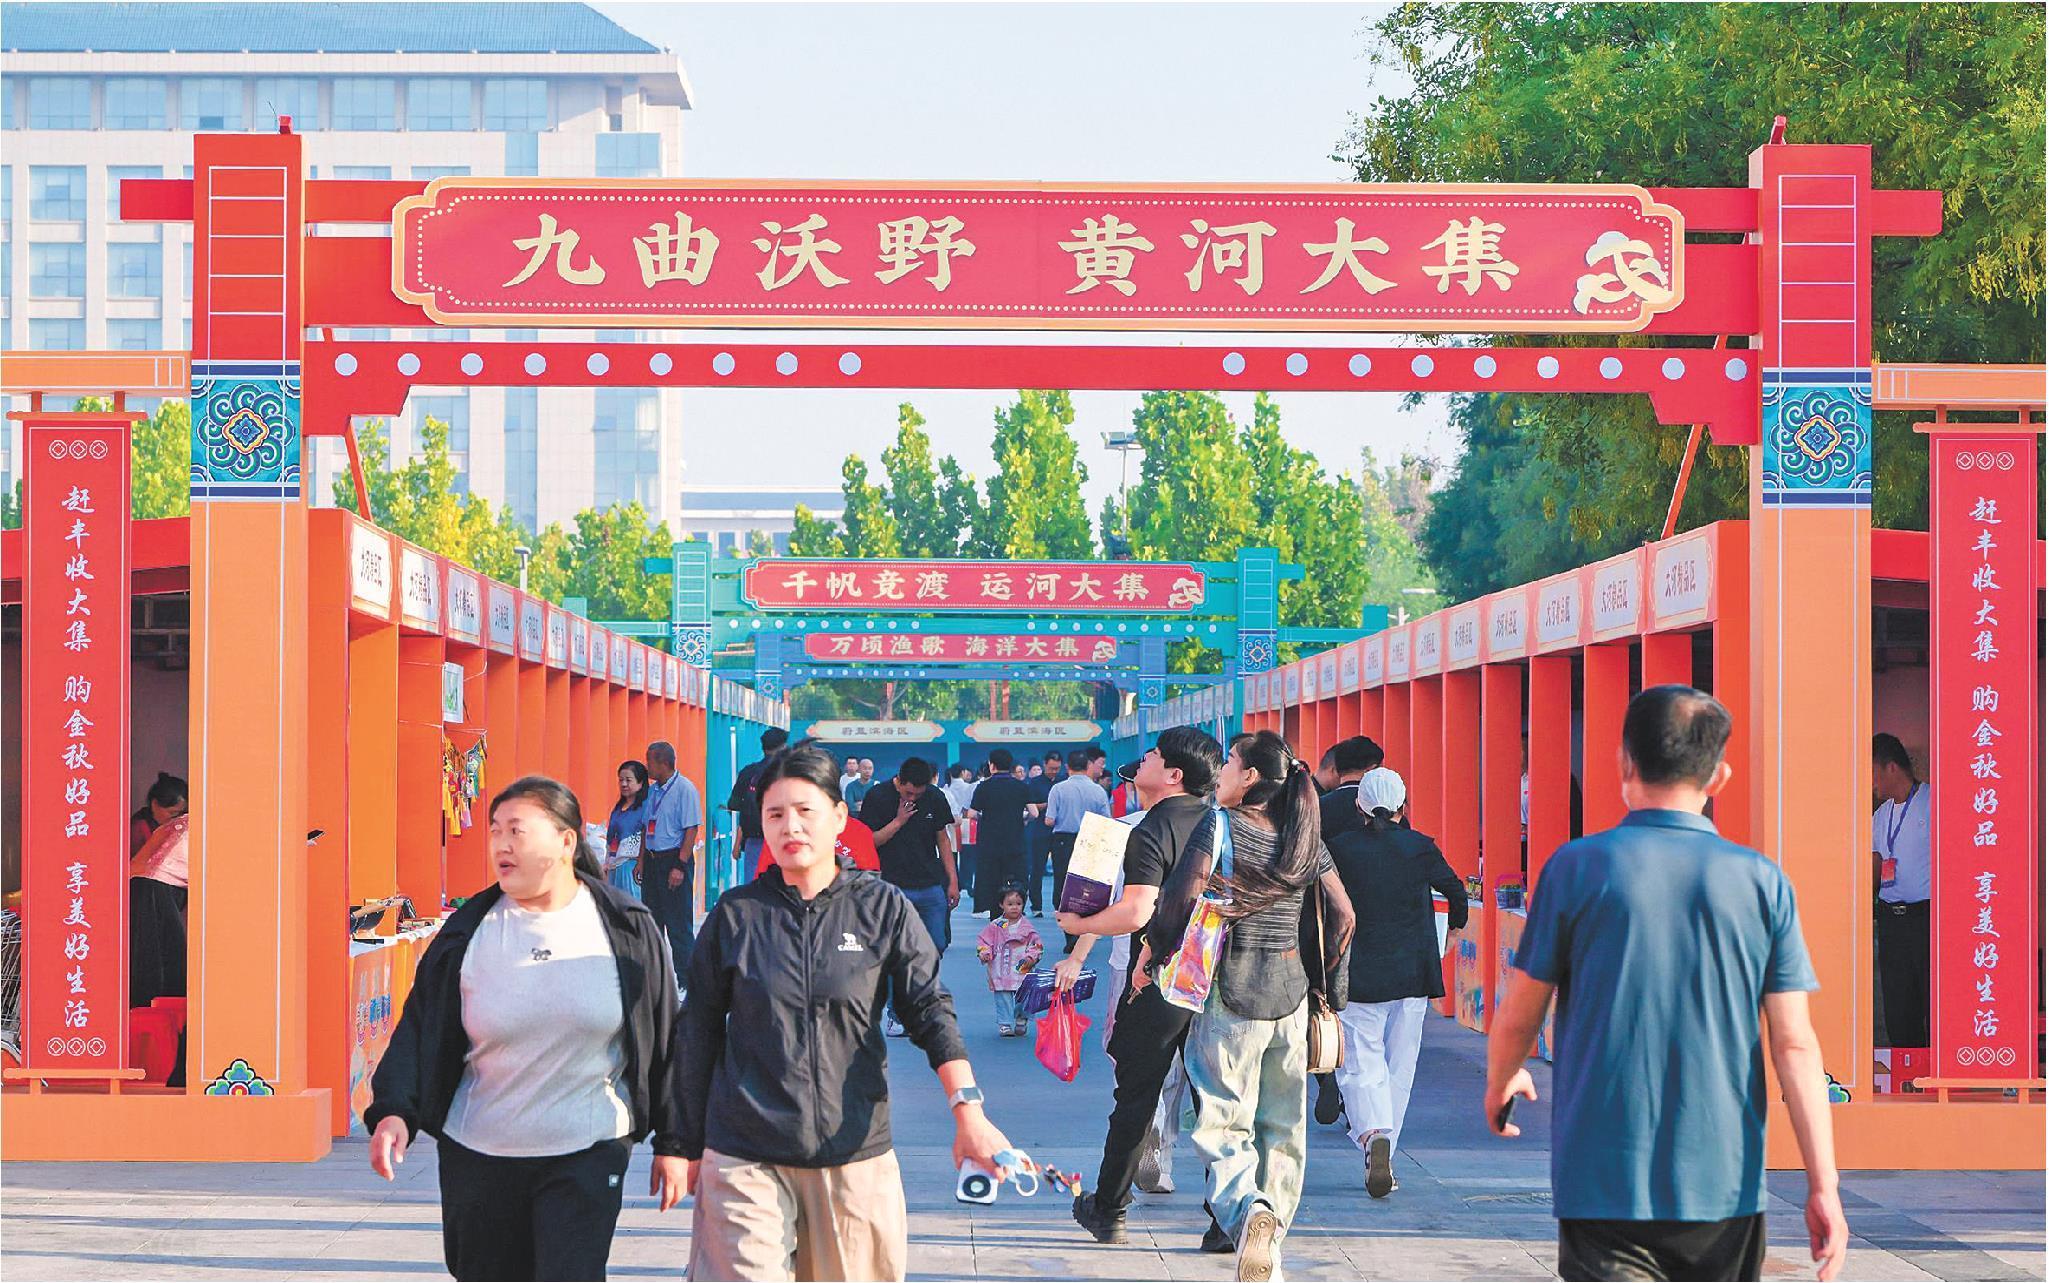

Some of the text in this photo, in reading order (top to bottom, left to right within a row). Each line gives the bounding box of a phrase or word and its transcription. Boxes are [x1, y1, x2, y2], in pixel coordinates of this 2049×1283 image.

[502, 211, 1519, 297] 九曲沃野 黄河大集
[782, 568, 1152, 602] 千帆竞渡 运河大集
[830, 636, 1079, 658] 万顷渔歌 海洋大集
[61, 485, 95, 1028] 赶丰收大集 购金秋好品 享美好生活
[1968, 496, 2002, 1037] 赶丰收大集 购金秋好品 享美好生活
